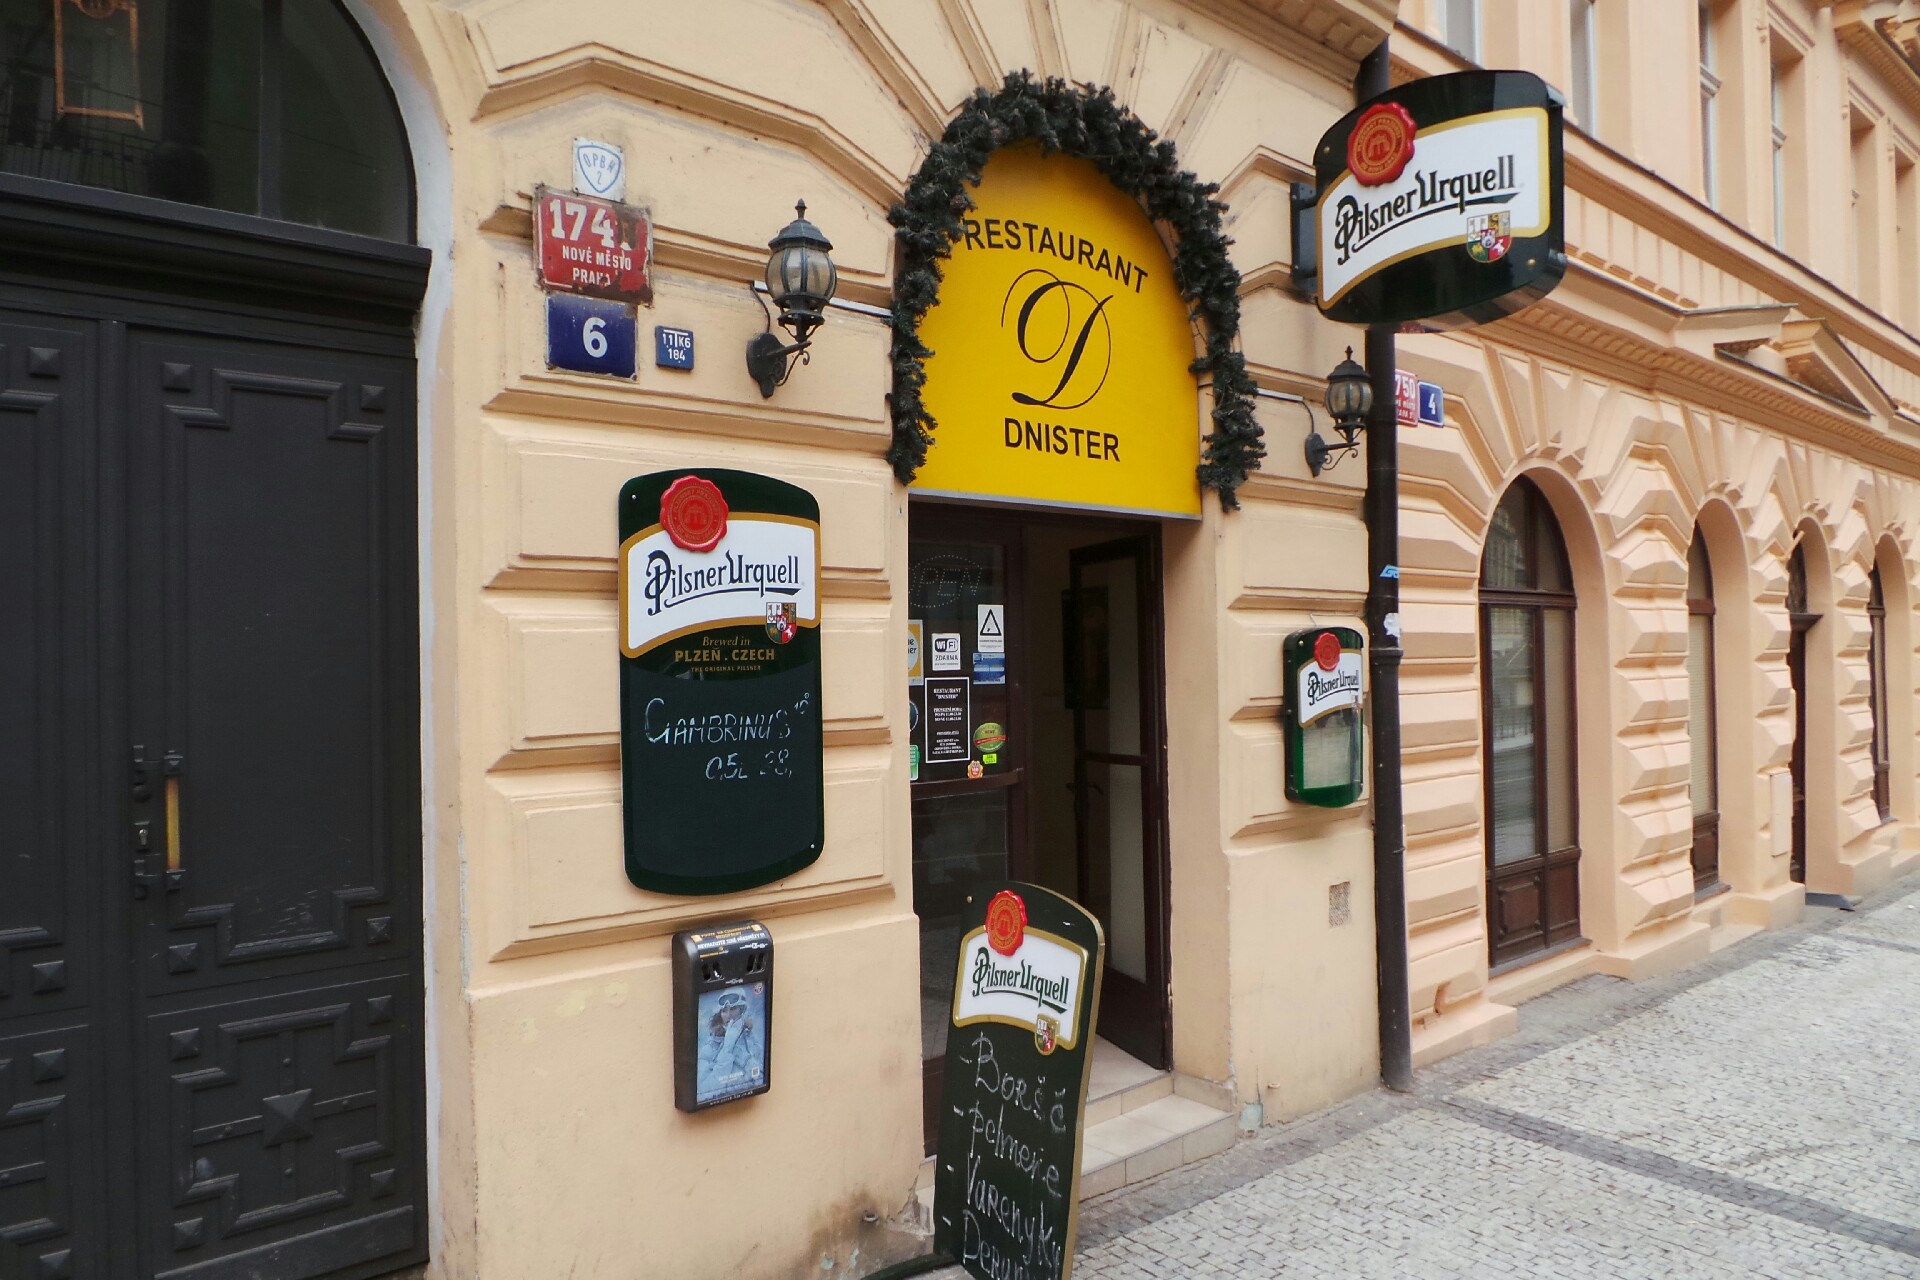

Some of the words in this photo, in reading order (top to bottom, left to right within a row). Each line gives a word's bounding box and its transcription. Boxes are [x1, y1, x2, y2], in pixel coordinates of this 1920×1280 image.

[1334, 188, 1417, 265] Pilsner
[1415, 154, 1515, 214] Urquell
[562, 245, 592, 263] NOVÉ
[963, 218, 1149, 294] RESTAURANT
[582, 317, 608, 358] 6
[668, 348, 685, 361] 184
[1001, 269, 1114, 410] D
[1428, 393, 1436, 415] 4
[1004, 417, 1121, 463] DNISTER
[644, 550, 726, 616] Pilsner
[725, 550, 800, 598] Urquell
[702, 636, 738, 646] Brewed
[741, 636, 750, 646] in
[731, 648, 775, 661] CZECH
[1307, 671, 1340, 706] Pilsner
[972, 947, 1021, 997] Pilsner
[1020, 959, 1070, 1008] Urquell
